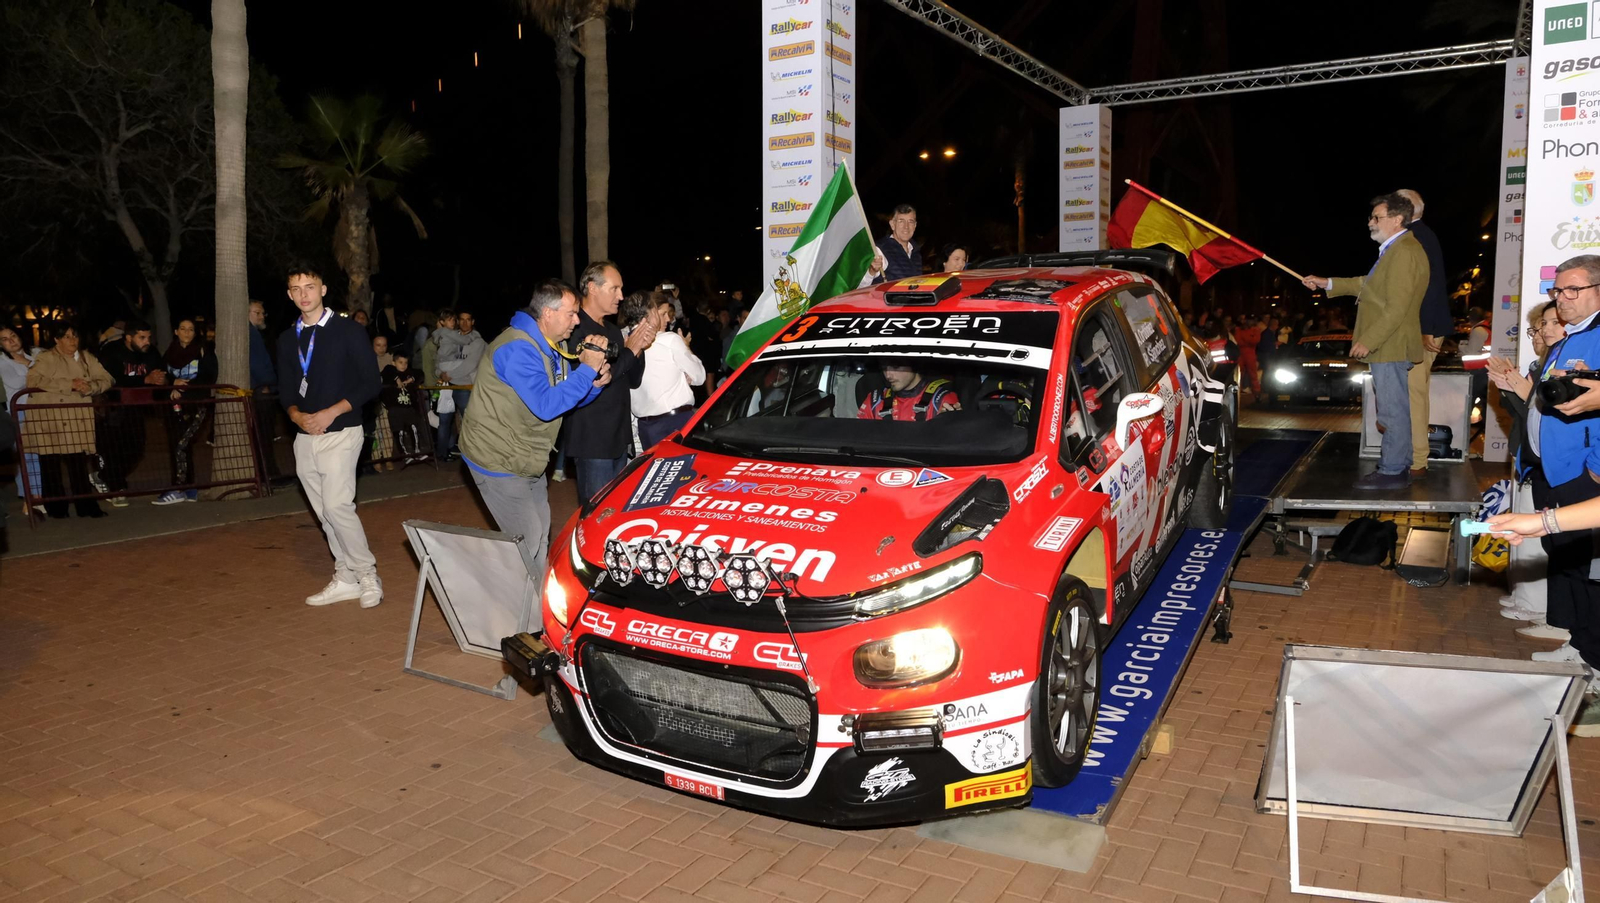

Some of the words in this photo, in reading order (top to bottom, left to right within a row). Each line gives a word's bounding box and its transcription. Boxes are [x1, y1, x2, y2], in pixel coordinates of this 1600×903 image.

[771, 20, 813, 34] Rallycar
[1548, 16, 1583, 31] UNED
[777, 44, 806, 57] Recalvi
[781, 69, 812, 78] MICHELIN
[771, 112, 813, 124] Rallycar
[1543, 121, 1583, 129] Correduria
[777, 135, 806, 147] Recalvi
[781, 159, 812, 167] MICHELIN
[771, 201, 813, 213] Rallycar
[827, 314, 1001, 329] CITROËN
[782, 316, 819, 342] 3
[819, 327, 1000, 335] RACING
[743, 471, 797, 480] Prefabricados
[750, 463, 861, 479] Prenava
[890, 471, 903, 480] E
[670, 495, 838, 522] Bimenes
[660, 509, 733, 521] INSTALACIONES
[744, 515, 827, 532] SANEAMIENTOS
[1044, 518, 1075, 546] TURINI
[627, 619, 710, 646] ORECA
[1082, 527, 1228, 767] www.garciaimpresores.e
[667, 775, 673, 785] S
[676, 778, 695, 791] 1339
[698, 784, 716, 797] BCL
[954, 771, 1029, 802] PIRELLI
